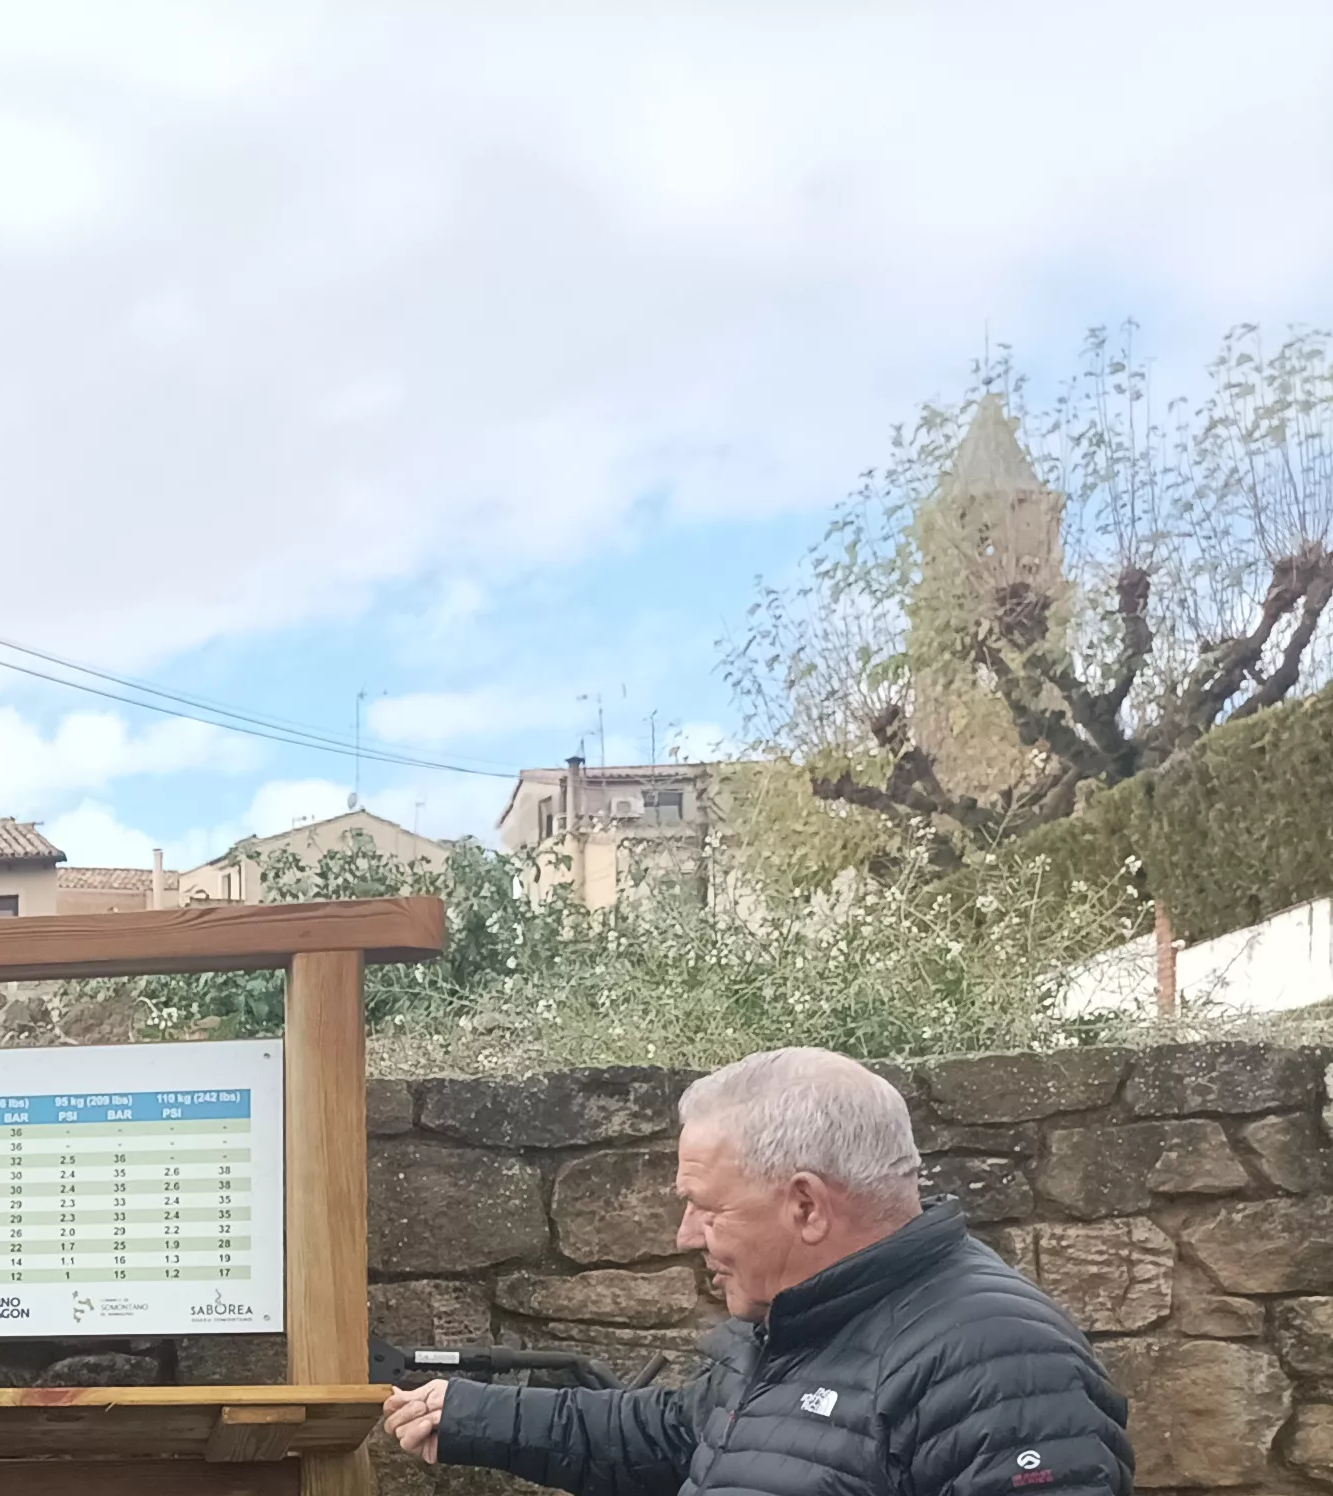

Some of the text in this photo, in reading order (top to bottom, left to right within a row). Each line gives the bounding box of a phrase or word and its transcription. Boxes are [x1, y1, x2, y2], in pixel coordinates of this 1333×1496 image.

[7, 1097, 30, 1110] lbs)
[54, 1096, 69, 1108] 95
[69, 1096, 84, 1109] kg
[111, 1094, 133, 1107] lbs)
[156, 1091, 241, 1105] 110 kg (242 lbs)
[3, 1112, 29, 1124] BAR
[58, 1111, 78, 1122] PSI
[107, 1109, 133, 1120] BAR
[162, 1108, 182, 1119] PSI
[10, 1127, 23, 1138] 36
[10, 1156, 23, 1167] 32
[59, 1155, 76, 1165] 2.5
[113, 1153, 127, 1164] 36
[10, 1170, 23, 1181] 30
[60, 1169, 76, 1180] 2.4
[113, 1168, 127, 1178] 35
[163, 1167, 181, 1177] 2.6
[10, 1185, 23, 1196] 30
[60, 1184, 76, 1194] 2.4
[113, 1182, 127, 1193] 35
[164, 1181, 181, 1192] 2.6
[218, 1180, 232, 1190] 38
[9, 1199, 23, 1210] 29
[60, 1198, 76, 1209] 2.3
[164, 1196, 180, 1206] 2.4
[218, 1194, 232, 1205] 35
[9, 1228, 23, 1239] 26
[60, 1227, 76, 1237] 2.0
[113, 1226, 126, 1236] 29
[164, 1225, 180, 1235] 2.2
[218, 1224, 231, 1234] 32
[9, 1242, 23, 1253] 22
[60, 1241, 76, 1252] 1.7
[113, 1240, 127, 1251] 25
[164, 1239, 181, 1250] 1.9
[217, 1238, 231, 1249] 28
[10, 1271, 23, 1282] 12
[114, 1269, 127, 1280] 15
[164, 1268, 180, 1279] 1.2
[219, 1267, 231, 1278] 17
[100, 1303, 149, 1311] SOMONTANO
[190, 1303, 254, 1316] SABOREA
